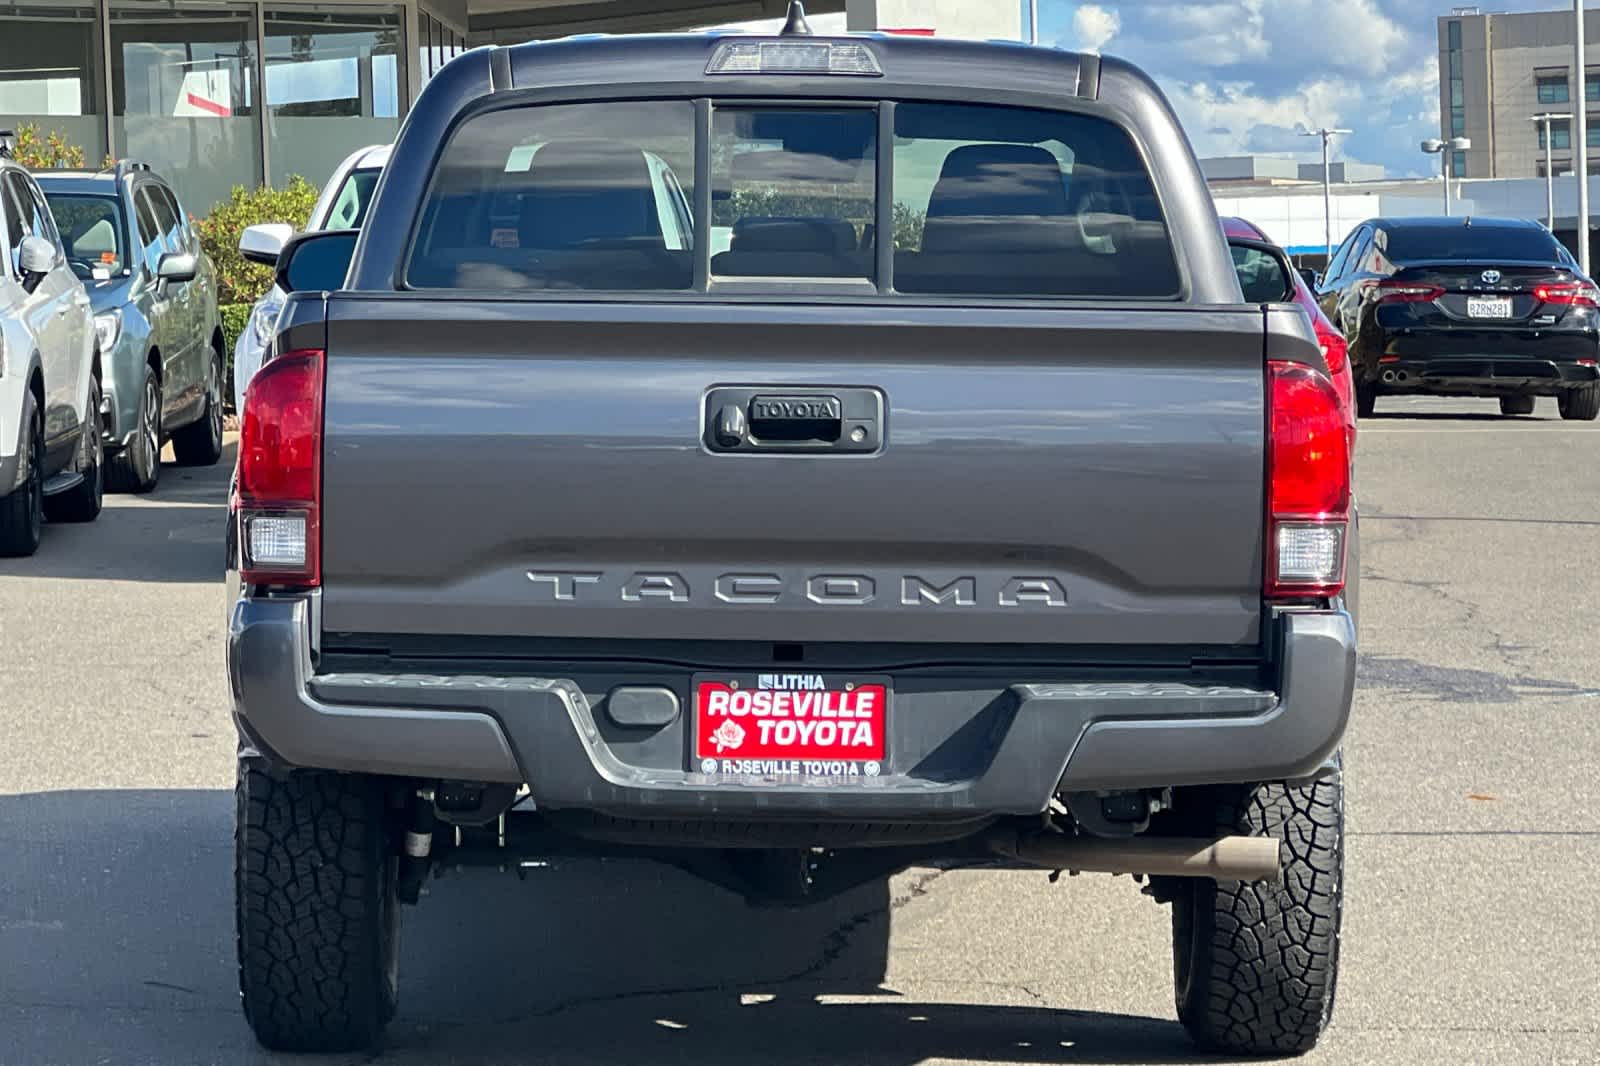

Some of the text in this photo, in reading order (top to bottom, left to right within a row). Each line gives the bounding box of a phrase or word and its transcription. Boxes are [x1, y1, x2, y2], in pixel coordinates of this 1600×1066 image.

[757, 401, 834, 417] TOYOTA
[526, 570, 1068, 606] TACOMA
[774, 674, 825, 689] LITHIA
[708, 691, 875, 718] ROSEVILLE
[757, 720, 874, 746] TOYOTA
